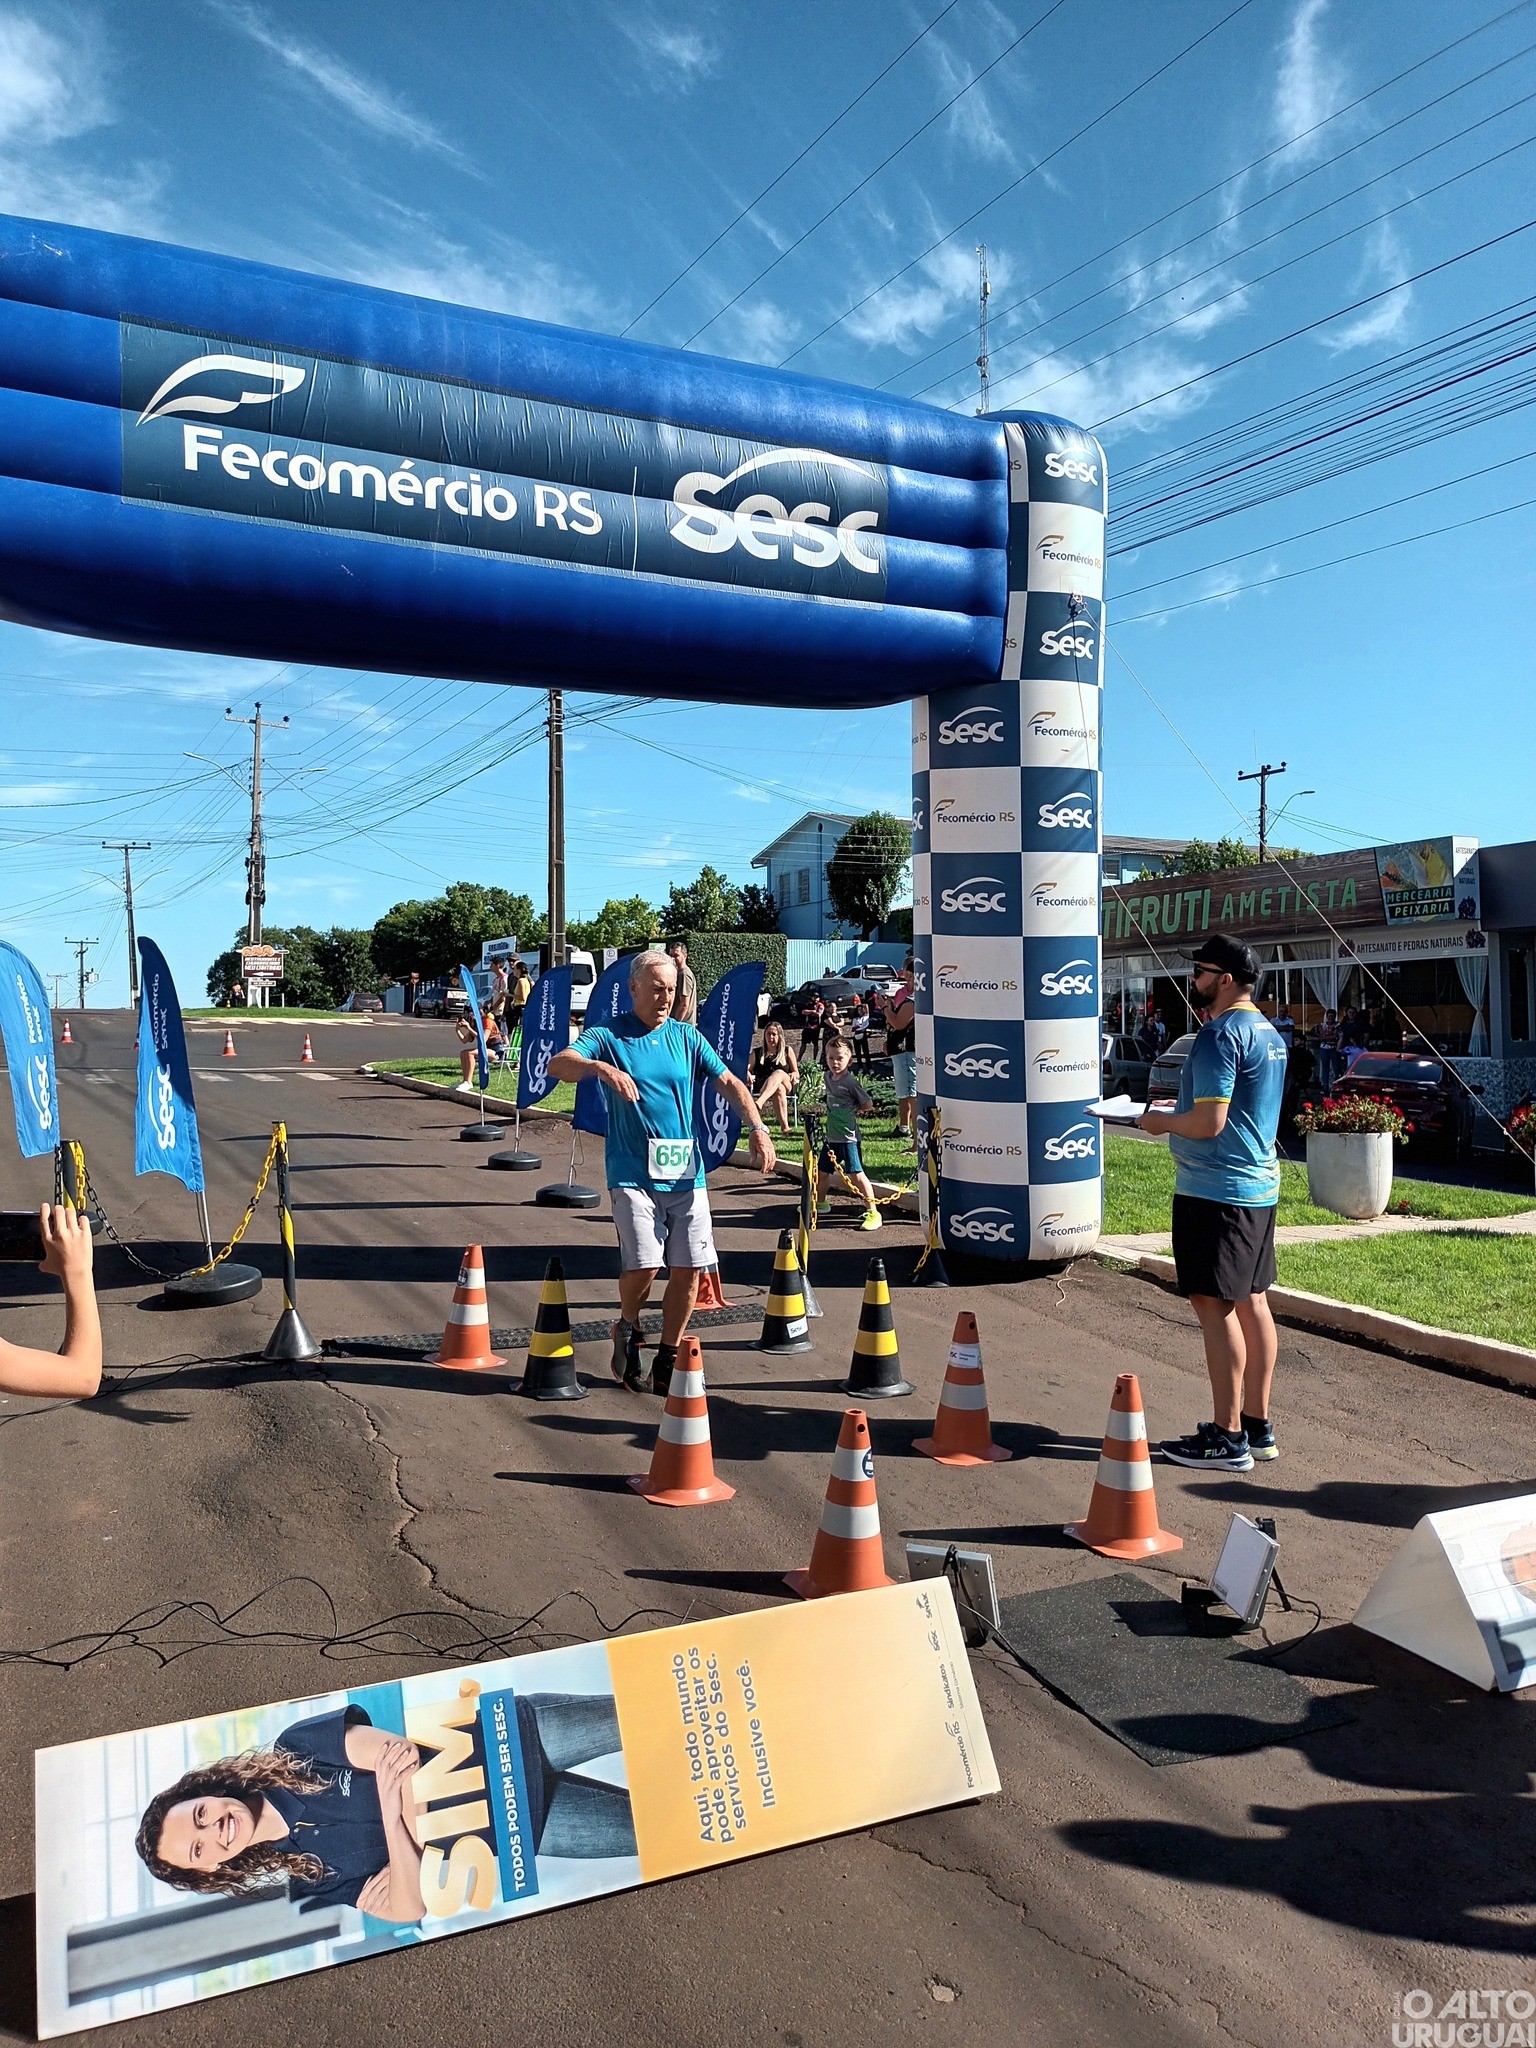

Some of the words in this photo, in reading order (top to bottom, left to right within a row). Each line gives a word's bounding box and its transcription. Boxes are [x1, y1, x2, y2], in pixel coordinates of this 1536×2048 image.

[182, 423, 518, 521] Fecomércio
[533, 483, 603, 535] RS
[1044, 452, 1098, 487] Sesc
[669, 471, 880, 574] Sesc
[1042, 549, 1094, 567] Fecomércio
[1094, 559, 1102, 569] RS
[1039, 630, 1095, 660] Sesc
[938, 720, 1005, 745] Sesc
[1034, 726, 1088, 739] Fecomércio
[1088, 730, 1097, 740] RS
[937, 812, 996, 823] Fecomércio
[999, 811, 1016, 822] RS
[1037, 803, 1093, 829] Sesc
[940, 889, 1006, 913] Sesc
[1036, 896, 1088, 907] Fecomércio
[1088, 896, 1096, 906] RS
[1103, 888, 1211, 940] TIFRUTI
[1221, 877, 1358, 920] AMETISTA
[1386, 887, 1453, 903] MERCEARIA
[1394, 902, 1450, 917] PEIXARIA
[1356, 942, 1397, 954] ARTESANATO
[1397, 942, 1402, 951] E
[1403, 940, 1429, 951] PEDRAS
[1430, 936, 1464, 949] NATURAIS
[940, 978, 999, 990] Fecomércio
[1001, 980, 1018, 991] RS
[1039, 972, 1094, 996] Sesc
[611, 982, 620, 1017] mércio
[726, 1020, 736, 1061] Senac
[529, 1038, 554, 1096] Sesc
[943, 1053, 1010, 1079] Sesc
[1039, 1060, 1090, 1073] Fecomércio
[1090, 1059, 1098, 1069] RS
[34, 1055, 53, 1130] Sesc
[156, 1063, 176, 1150] Sesc
[708, 1092, 730, 1157] Ses
[656, 1144, 691, 1167] 656
[944, 1140, 1003, 1155] Fecomércio
[1006, 1146, 1022, 1156] RS
[1044, 1135, 1096, 1161] Sesc
[949, 1214, 1015, 1243] Sesc
[1044, 1223, 1093, 1237] Fecomércio
[1204, 1446, 1228, 1458] FILA
[688, 1646, 701, 1670] os
[672, 1653, 695, 1725] mundo
[706, 1653, 723, 1705] Sesc.
[735, 1659, 757, 1713] você.
[493, 1697, 508, 1741] SESC.
[693, 1676, 722, 1781] aproveitar
[714, 1710, 730, 1738] do
[953, 1721, 961, 1735] RS
[497, 1742, 514, 1774] SER
[685, 1731, 704, 1782] todo
[750, 1718, 776, 1808] Inclusive
[957, 1736, 974, 1789] Fecomércio
[342, 1769, 353, 1798] Sesc
[722, 1743, 747, 1829] serviços
[502, 1775, 521, 1832] PODEM
[694, 1786, 715, 1842] Aqui,
[711, 1787, 735, 1843] pode
[509, 1834, 527, 1891] TODOS
